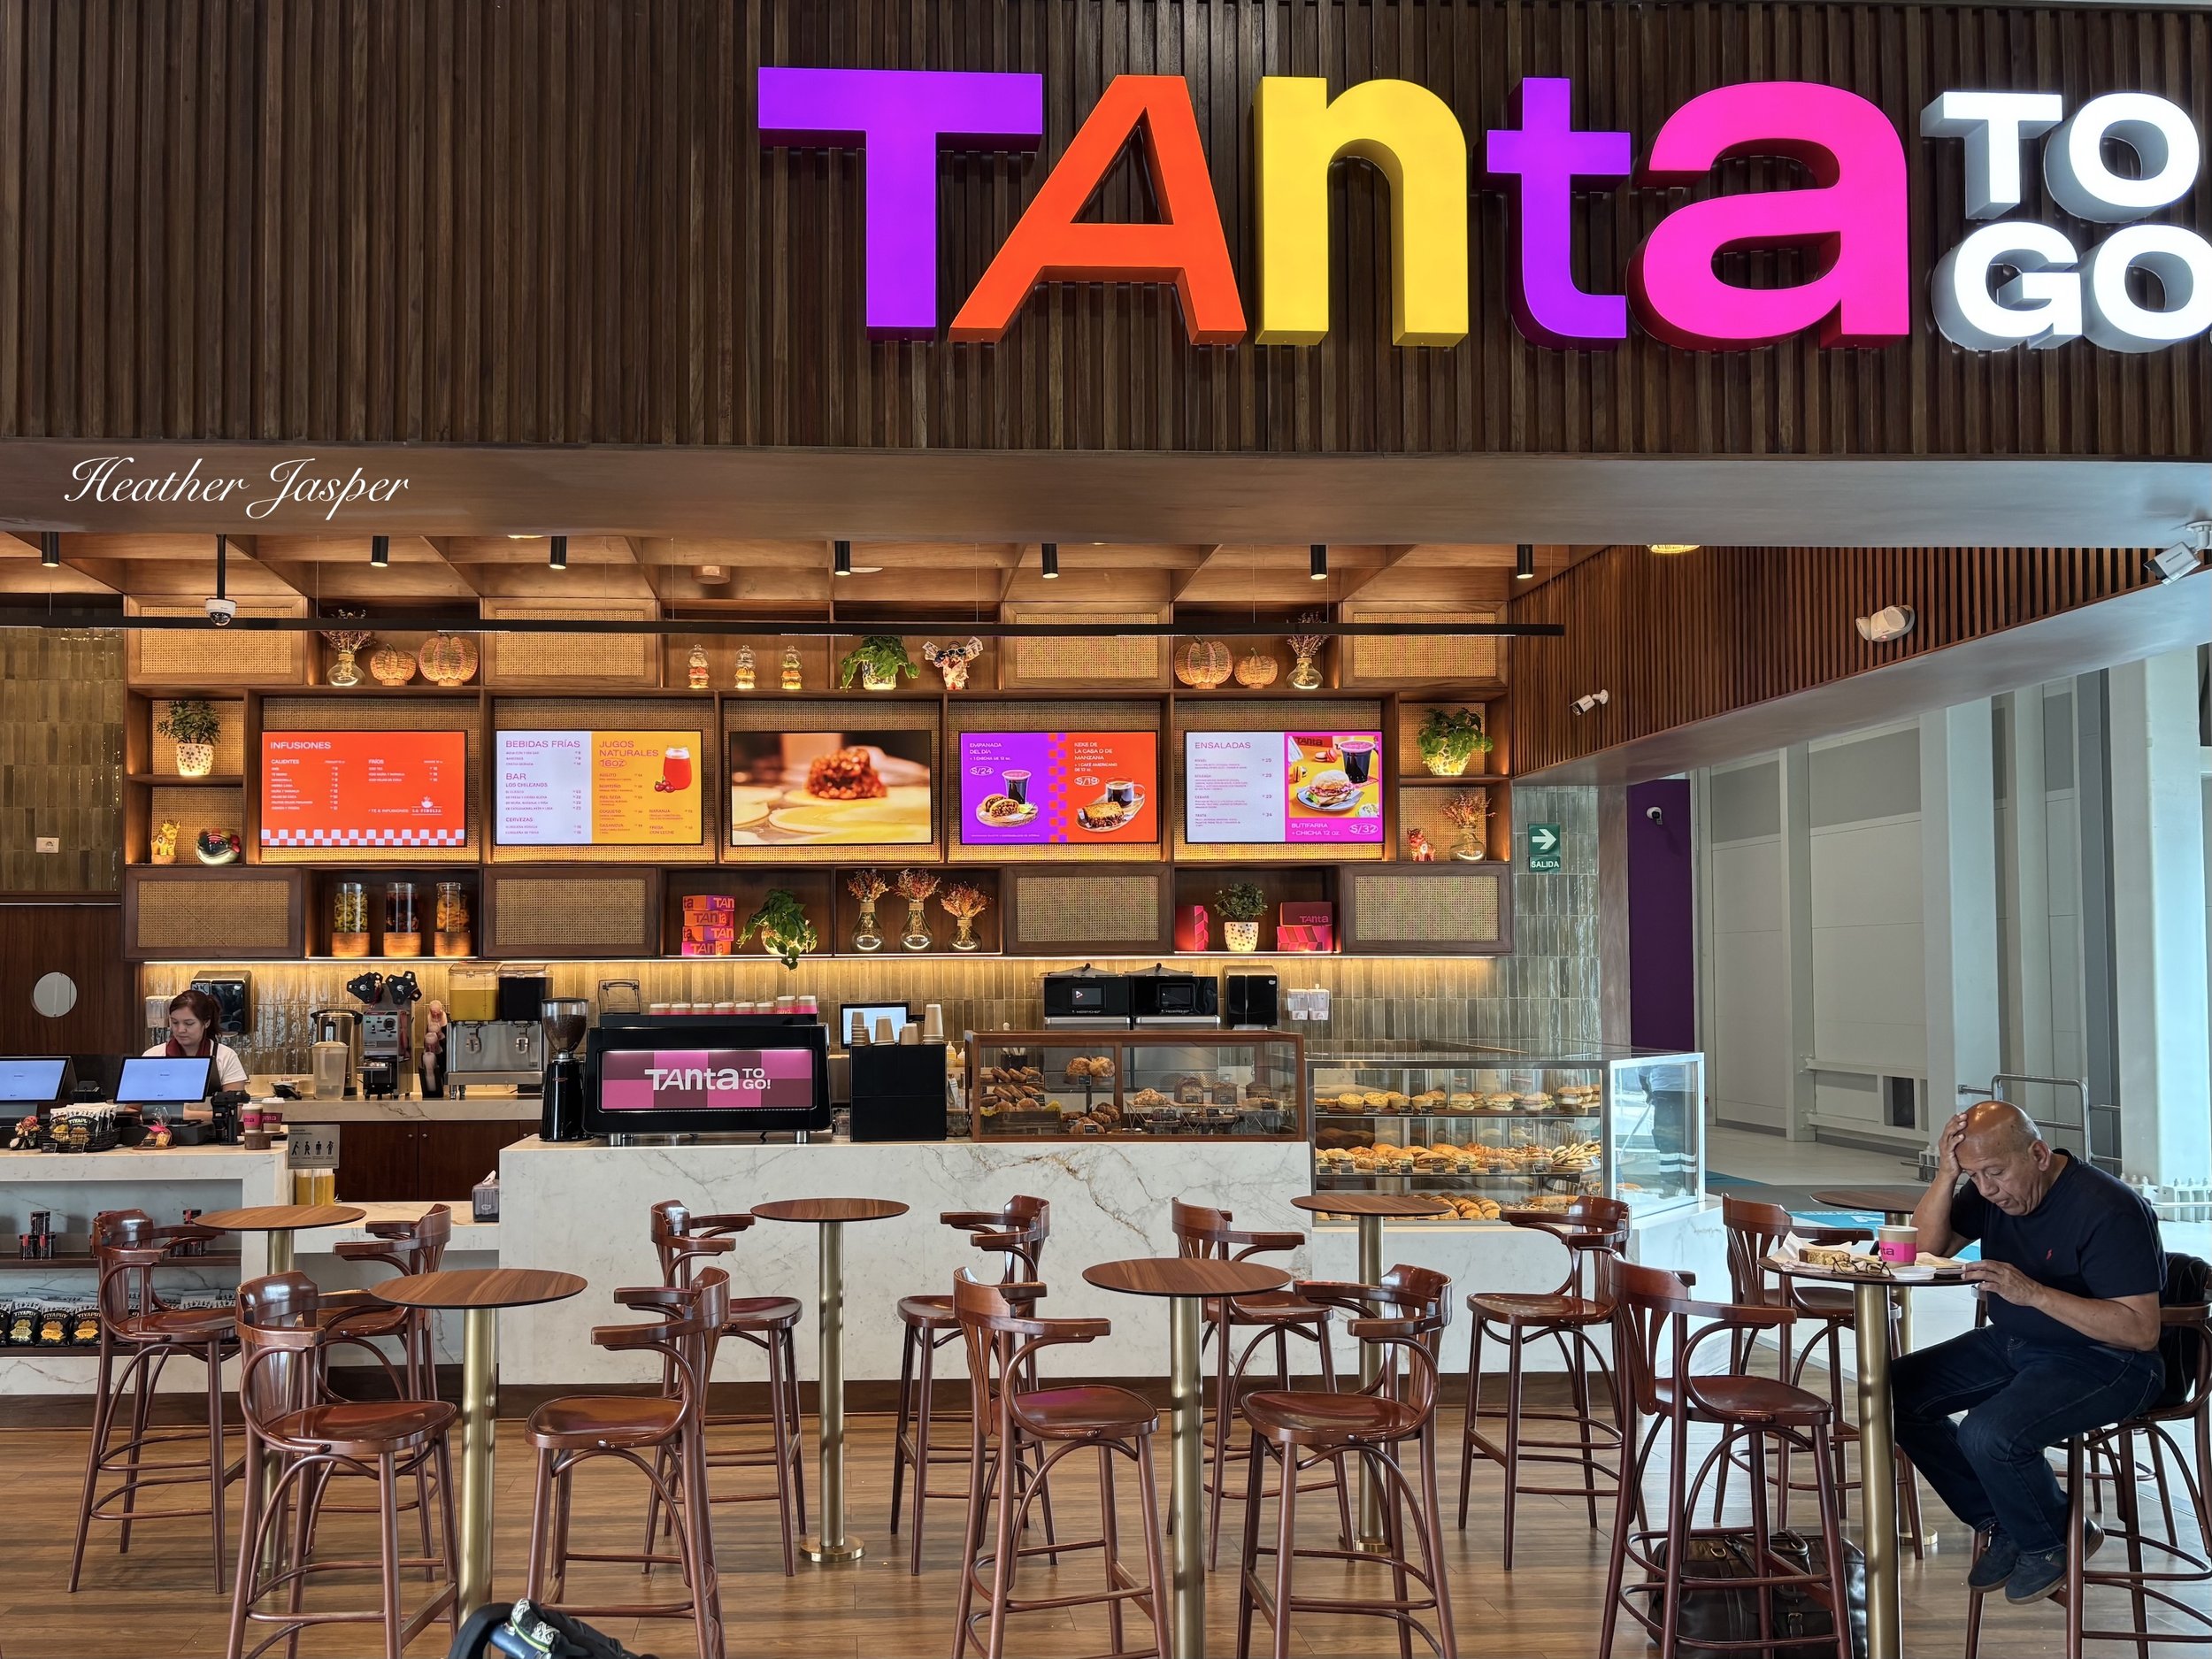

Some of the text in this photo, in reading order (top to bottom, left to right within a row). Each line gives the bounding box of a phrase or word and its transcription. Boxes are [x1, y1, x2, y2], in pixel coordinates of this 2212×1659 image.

[1938, 90, 2201, 212] TO
[1947, 220, 2212, 342] GO
[551, 739, 580, 748] FRÍAS
[1349, 825, 1378, 833] S/32
[742, 1068, 765, 1079] TO
[742, 1079, 772, 1090] GO!
